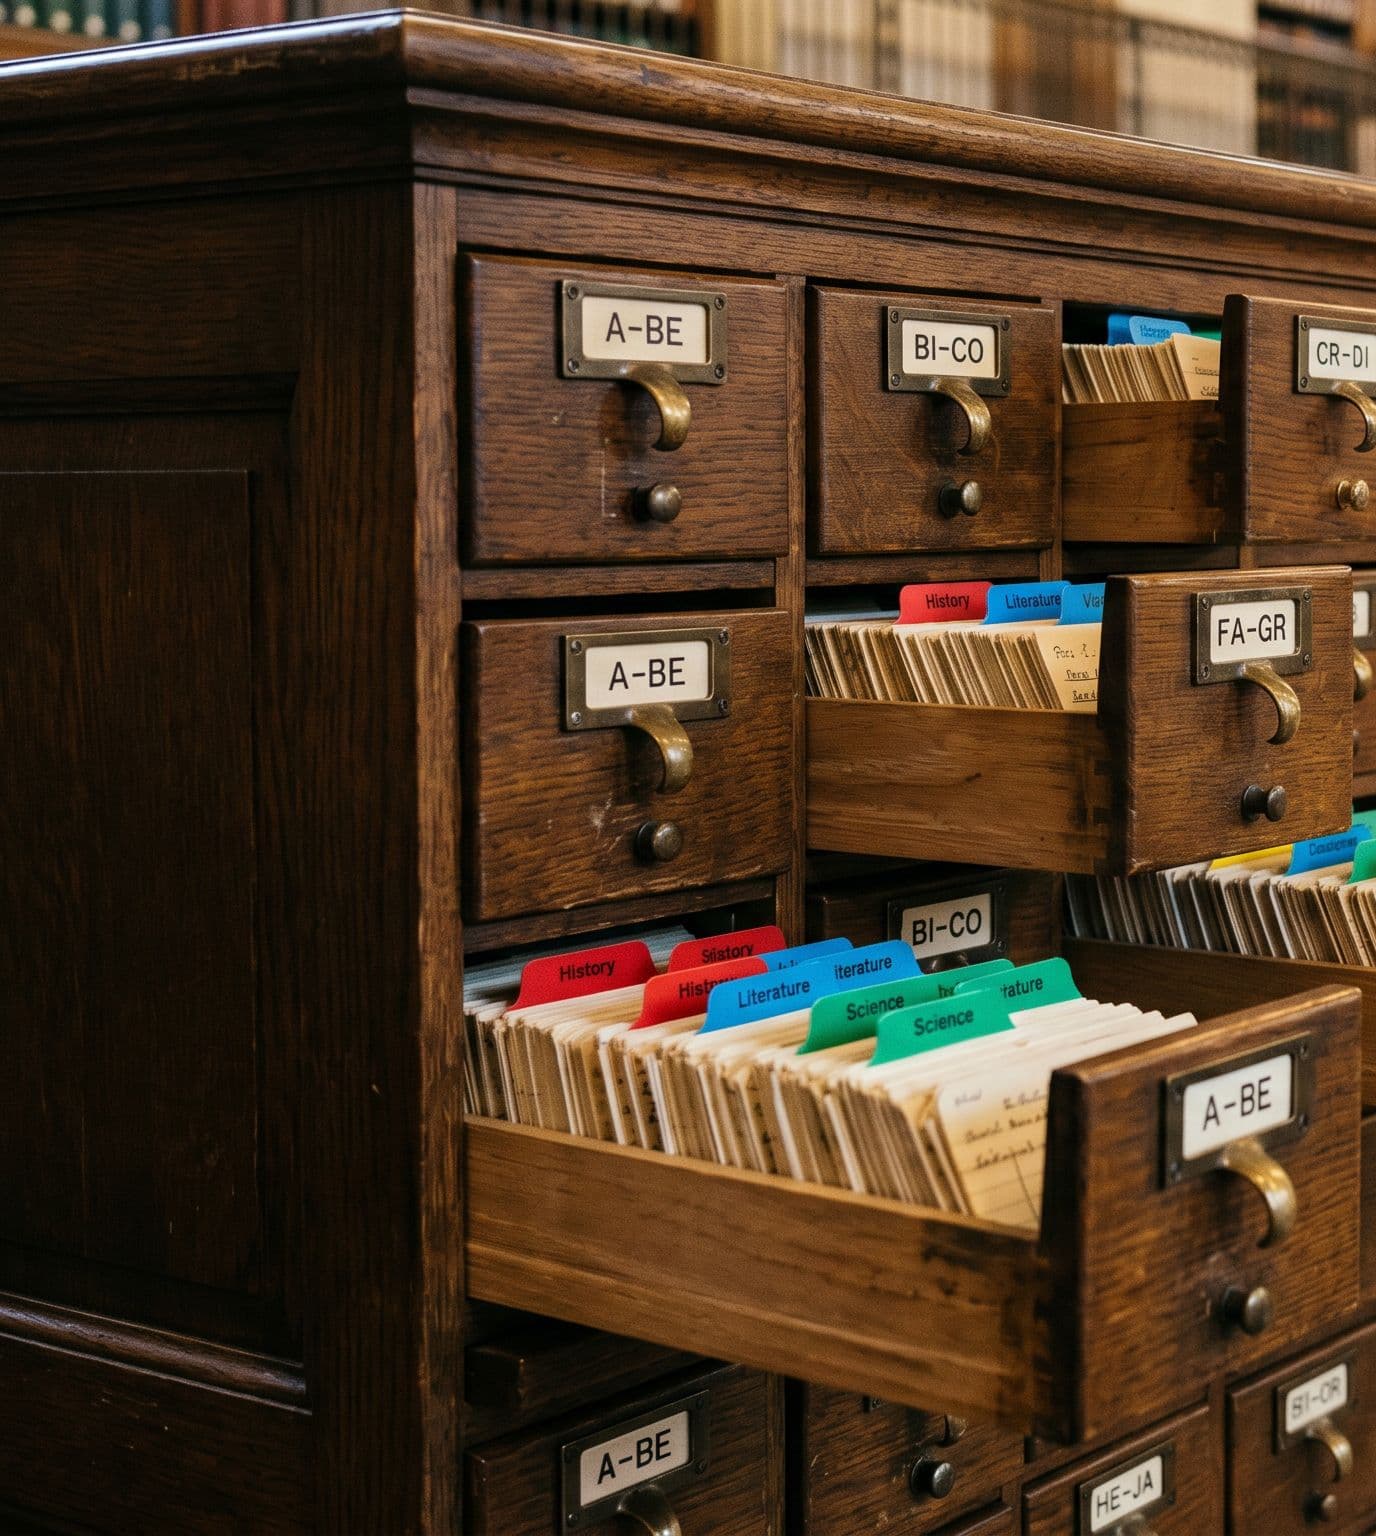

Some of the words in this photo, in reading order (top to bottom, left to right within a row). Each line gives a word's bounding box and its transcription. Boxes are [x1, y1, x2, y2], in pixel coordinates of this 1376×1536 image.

[606, 311, 683, 346] A-BE
[914, 333, 984, 364] BI-CO
[1317, 341, 1369, 369] CR-DI
[925, 593, 970, 610] History
[1005, 594, 1061, 610] Literature
[1217, 613, 1286, 647] FA-GR
[608, 657, 686, 691] A-BE
[912, 908, 982, 946] BI-CO
[559, 960, 616, 982] History
[738, 979, 811, 1009] Literature
[846, 994, 905, 1022] Science
[913, 1008, 975, 1037] Science
[1203, 1076, 1271, 1131] A-BE
[597, 1428, 672, 1486] A-BE
[1096, 1470, 1154, 1518] HE-JA
